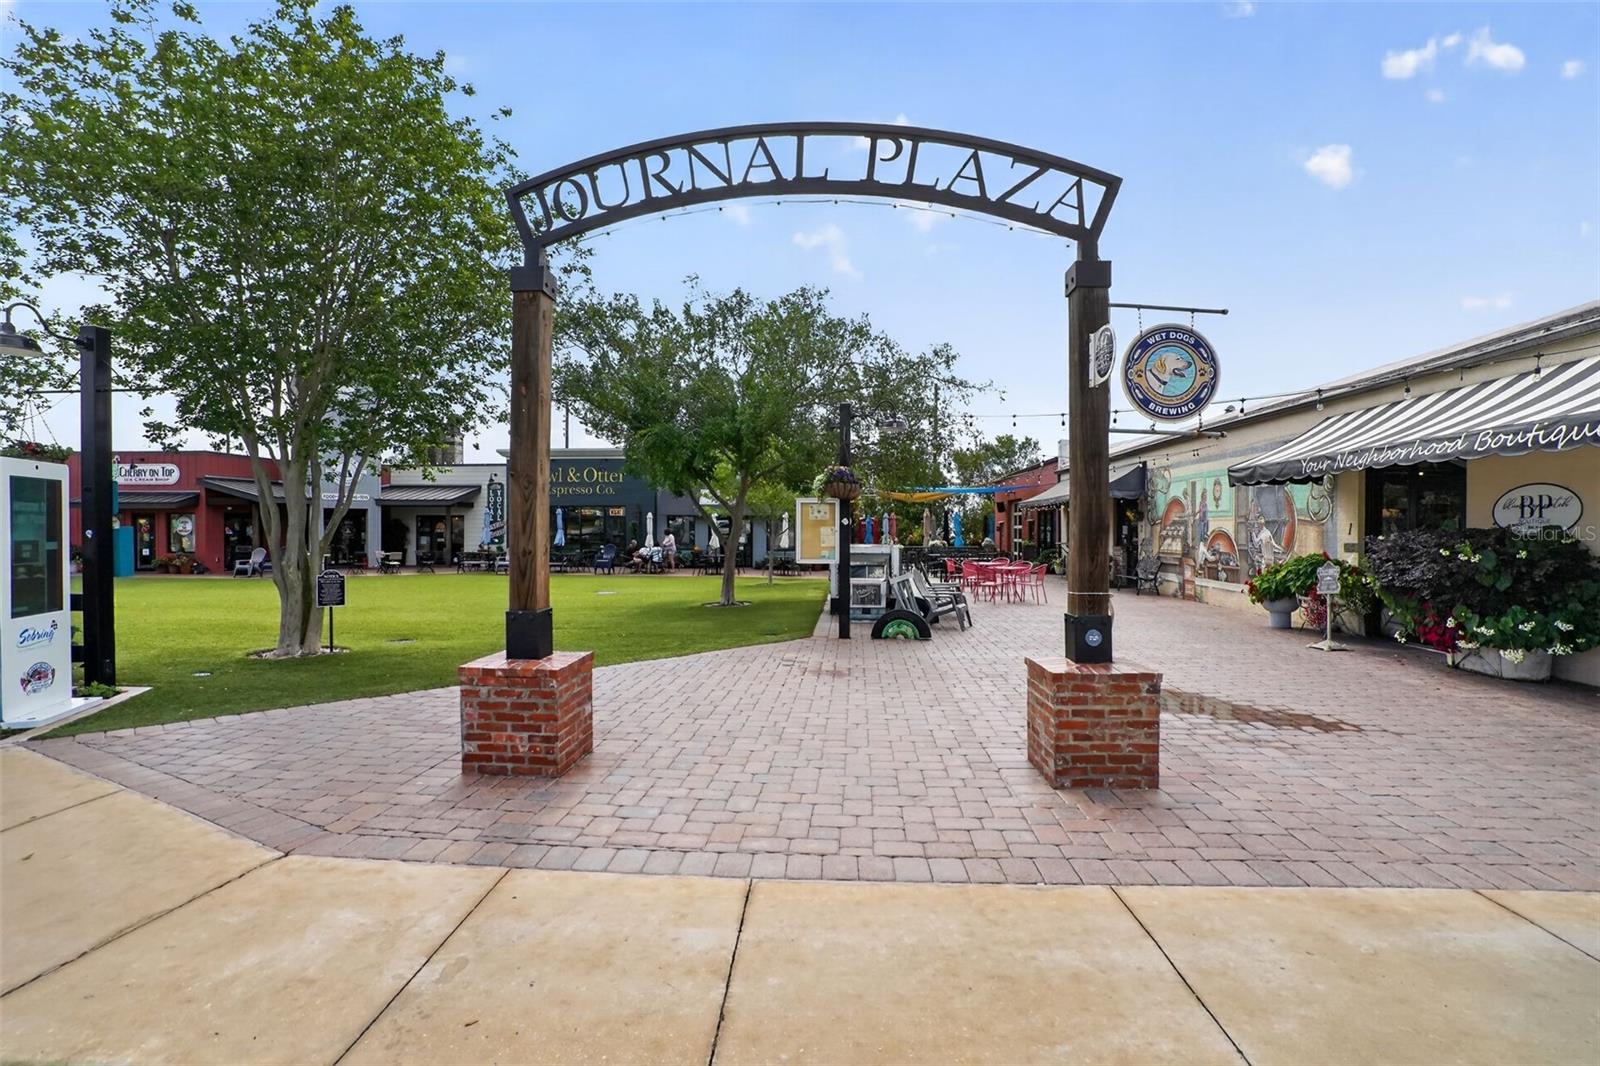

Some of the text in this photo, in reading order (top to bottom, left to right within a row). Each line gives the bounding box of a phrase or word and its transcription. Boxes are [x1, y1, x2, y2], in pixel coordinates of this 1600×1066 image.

[527, 134, 1086, 232] JOURNAL PLAZA
[1146, 331, 1196, 344] WET DOGS
[1148, 402, 1196, 415] BREWING
[1301, 421, 1600, 474] Your Neighborhood Boutiqu
[119, 466, 175, 478] CHERRY ON TOP
[549, 467, 626, 483] wl & Otter
[549, 484, 616, 497] spresso Co.
[1520, 494, 1553, 519] BP
[19, 628, 55, 644] Sebring
